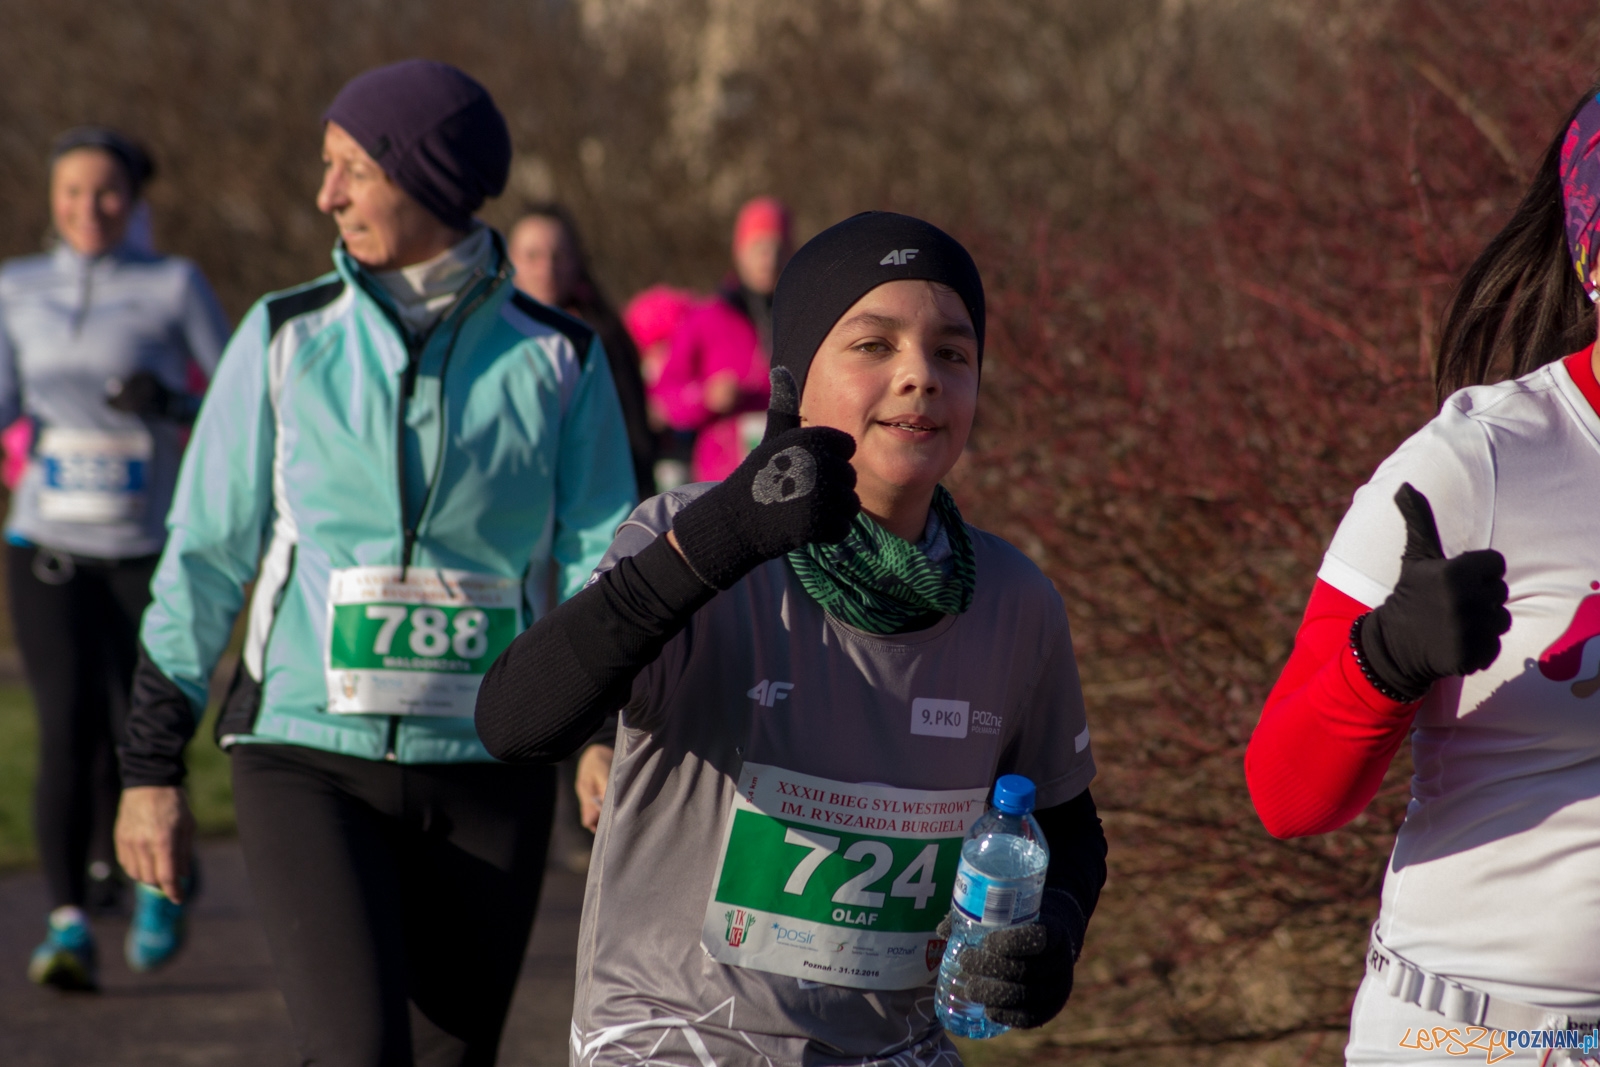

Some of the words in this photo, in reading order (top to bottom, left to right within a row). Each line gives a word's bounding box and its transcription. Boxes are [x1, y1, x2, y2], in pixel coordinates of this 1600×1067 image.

[880, 248, 919, 265] 4F
[365, 605, 489, 659] 788
[747, 679, 794, 707] 4F
[776, 781, 826, 802] XXXII
[828, 792, 868, 810] BIEG
[871, 798, 972, 815] SYLWESTROWY
[780, 801, 806, 818] IM.
[810, 807, 897, 832] RYSZARDA
[900, 820, 964, 833] BURGIELA
[782, 826, 940, 910] 724
[735, 909, 746, 926] TK
[831, 908, 879, 927] OLAF
[803, 960, 832, 972] Poznań
